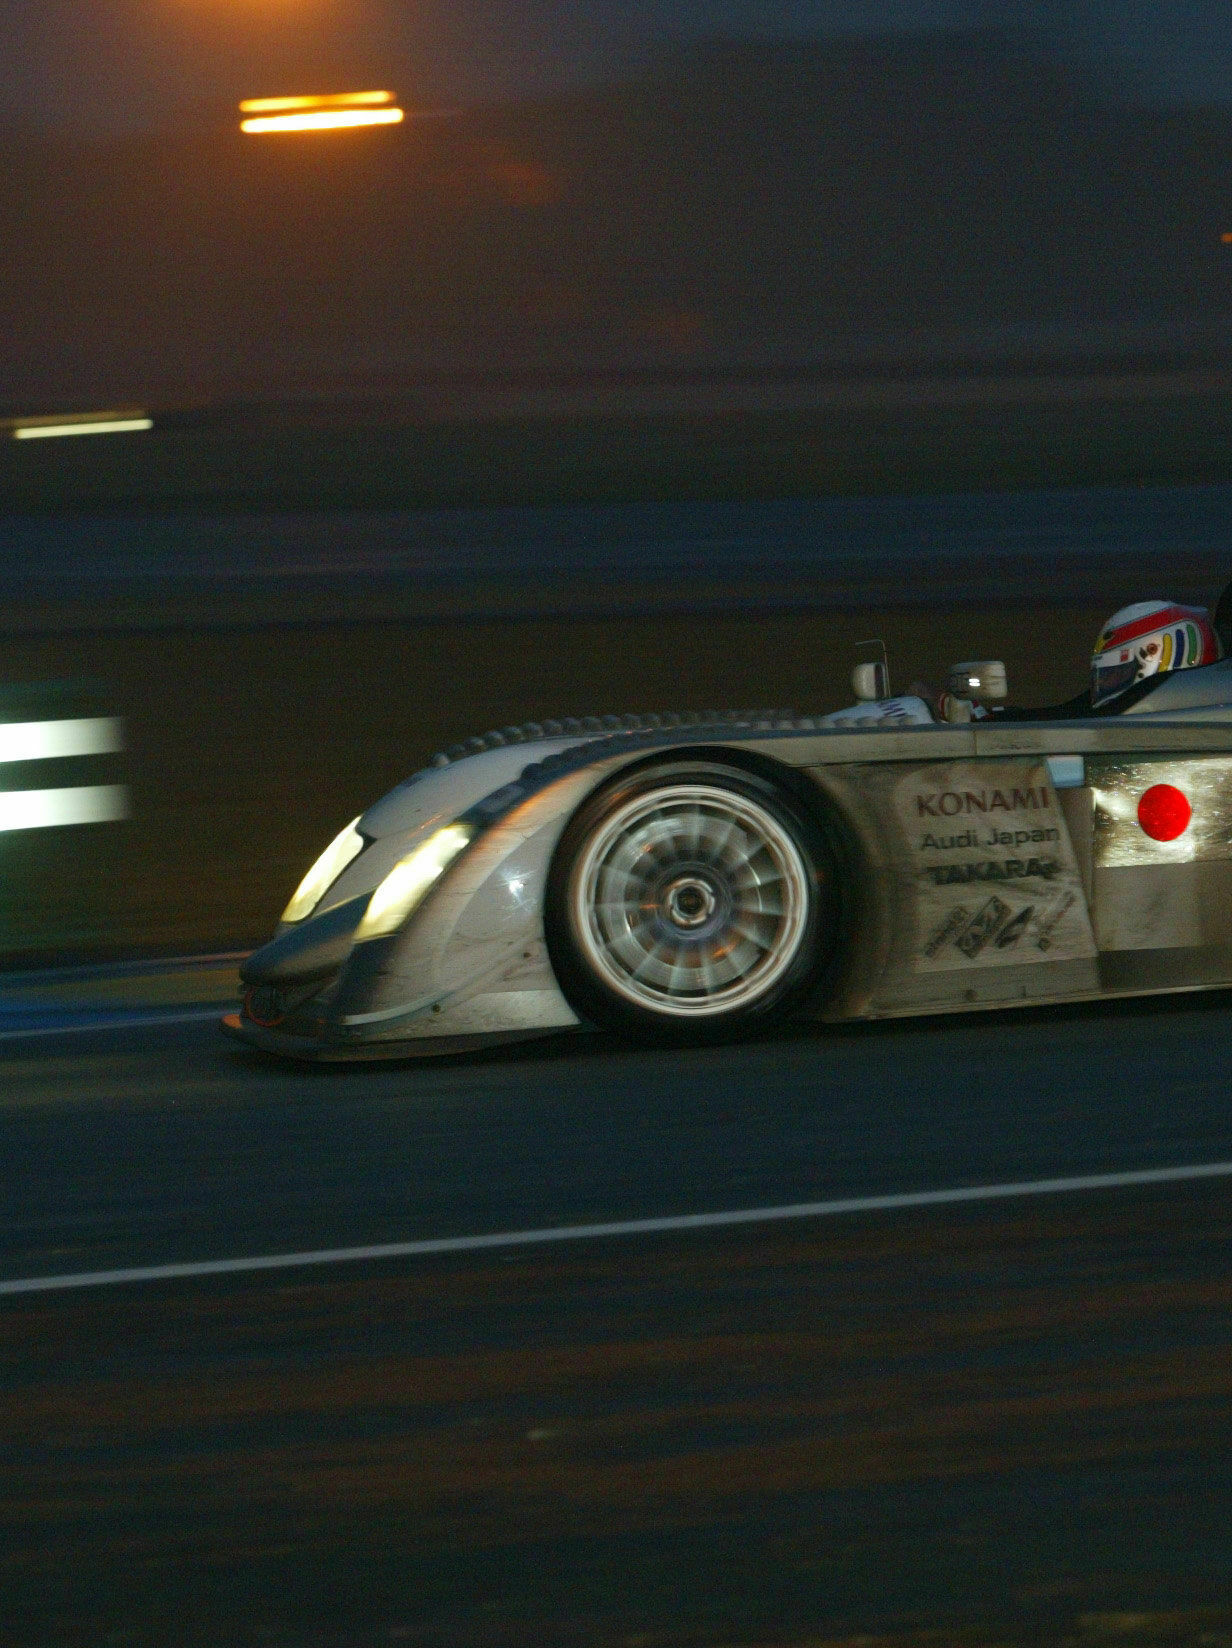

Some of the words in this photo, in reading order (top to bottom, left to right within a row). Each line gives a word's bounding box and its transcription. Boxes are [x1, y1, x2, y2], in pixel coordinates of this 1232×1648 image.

[916, 786, 1050, 817] KONAMI
[922, 830, 978, 850] Audi
[987, 827, 1060, 848] Japan
